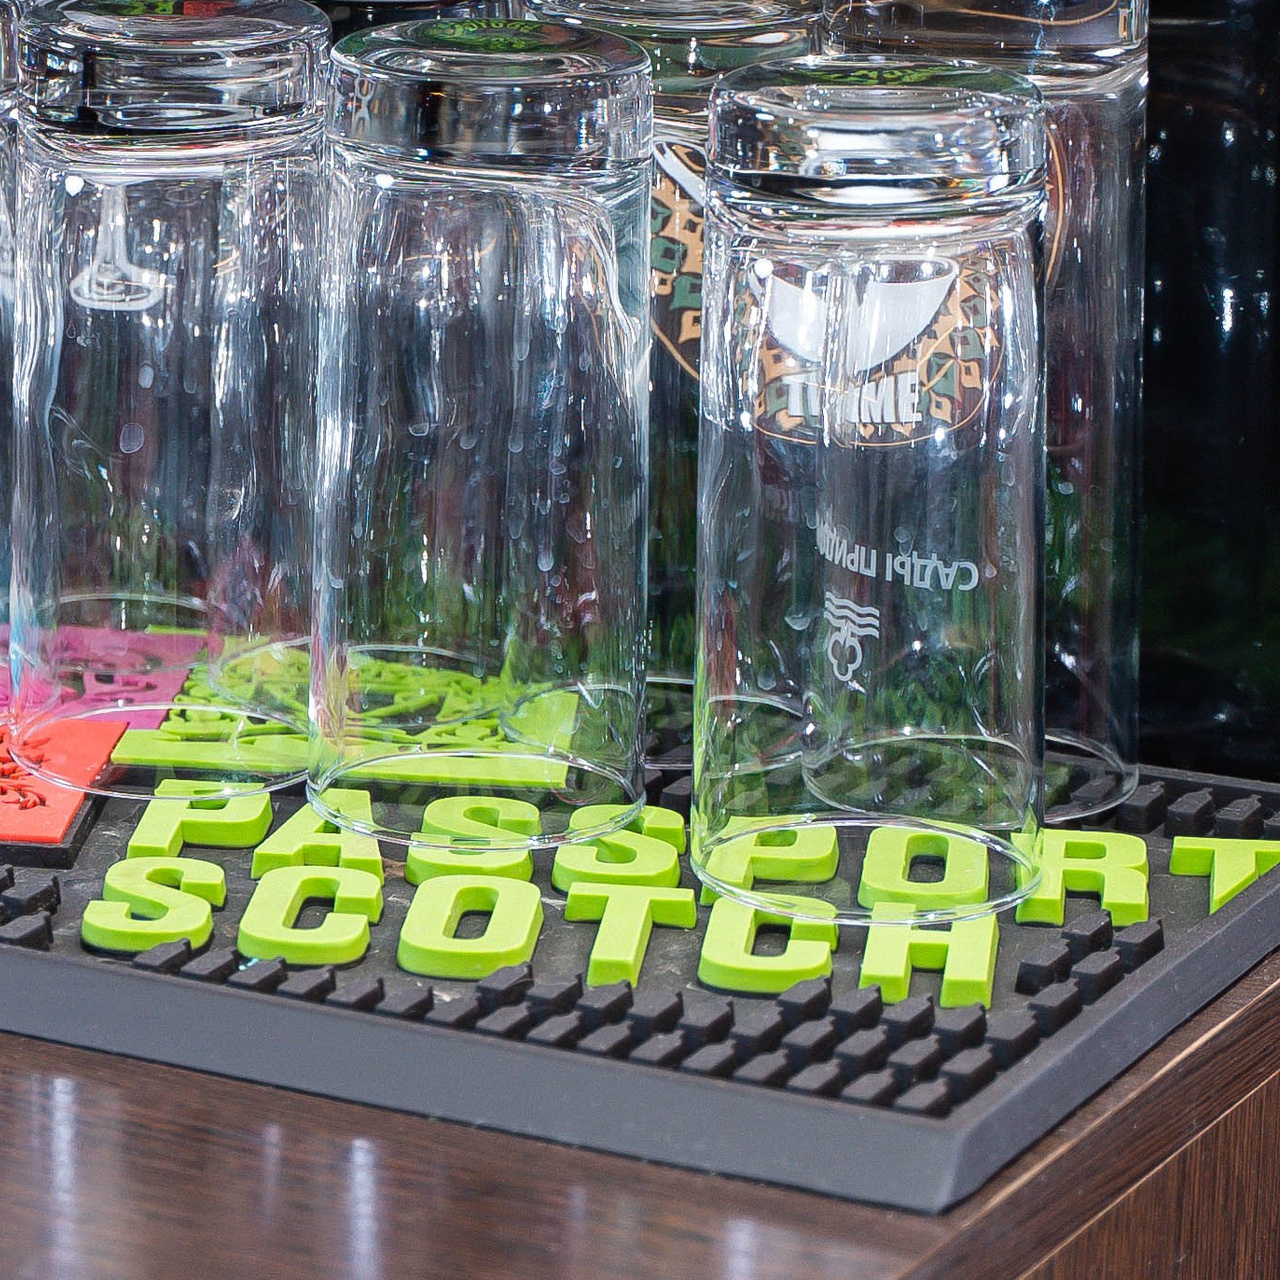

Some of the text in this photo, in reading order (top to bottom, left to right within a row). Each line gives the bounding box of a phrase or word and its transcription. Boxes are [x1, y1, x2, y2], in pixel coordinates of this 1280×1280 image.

[883, 549, 979, 590] САДЫ
[127, 779, 1280, 927] PASSPORT
[82, 856, 1000, 1009] SCOTCH
